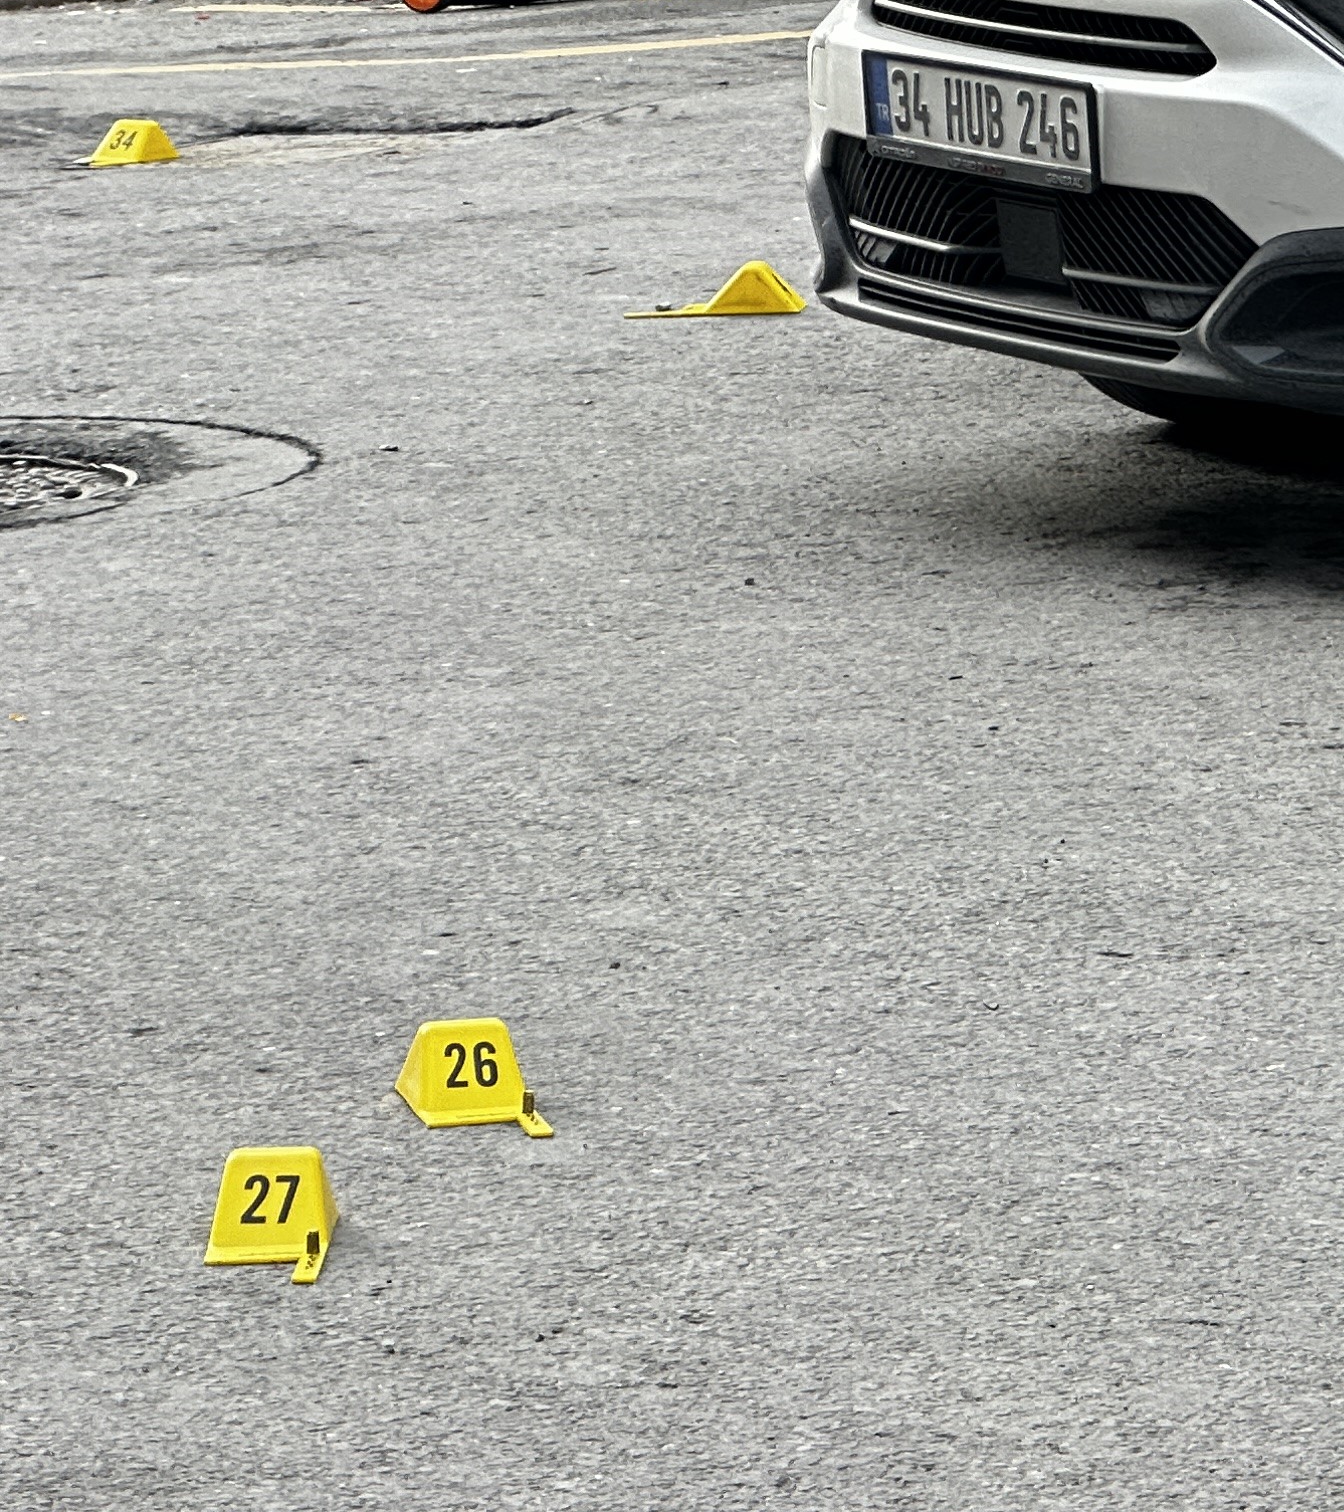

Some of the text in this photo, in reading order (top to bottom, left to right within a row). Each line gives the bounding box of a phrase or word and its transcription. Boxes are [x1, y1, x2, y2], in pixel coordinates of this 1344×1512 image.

[876, 102, 890, 122] TR
[891, 69, 1080, 162] 34 HUB 246
[109, 129, 138, 151] 34
[444, 1040, 499, 1089] 26
[240, 1173, 301, 1225] 27
